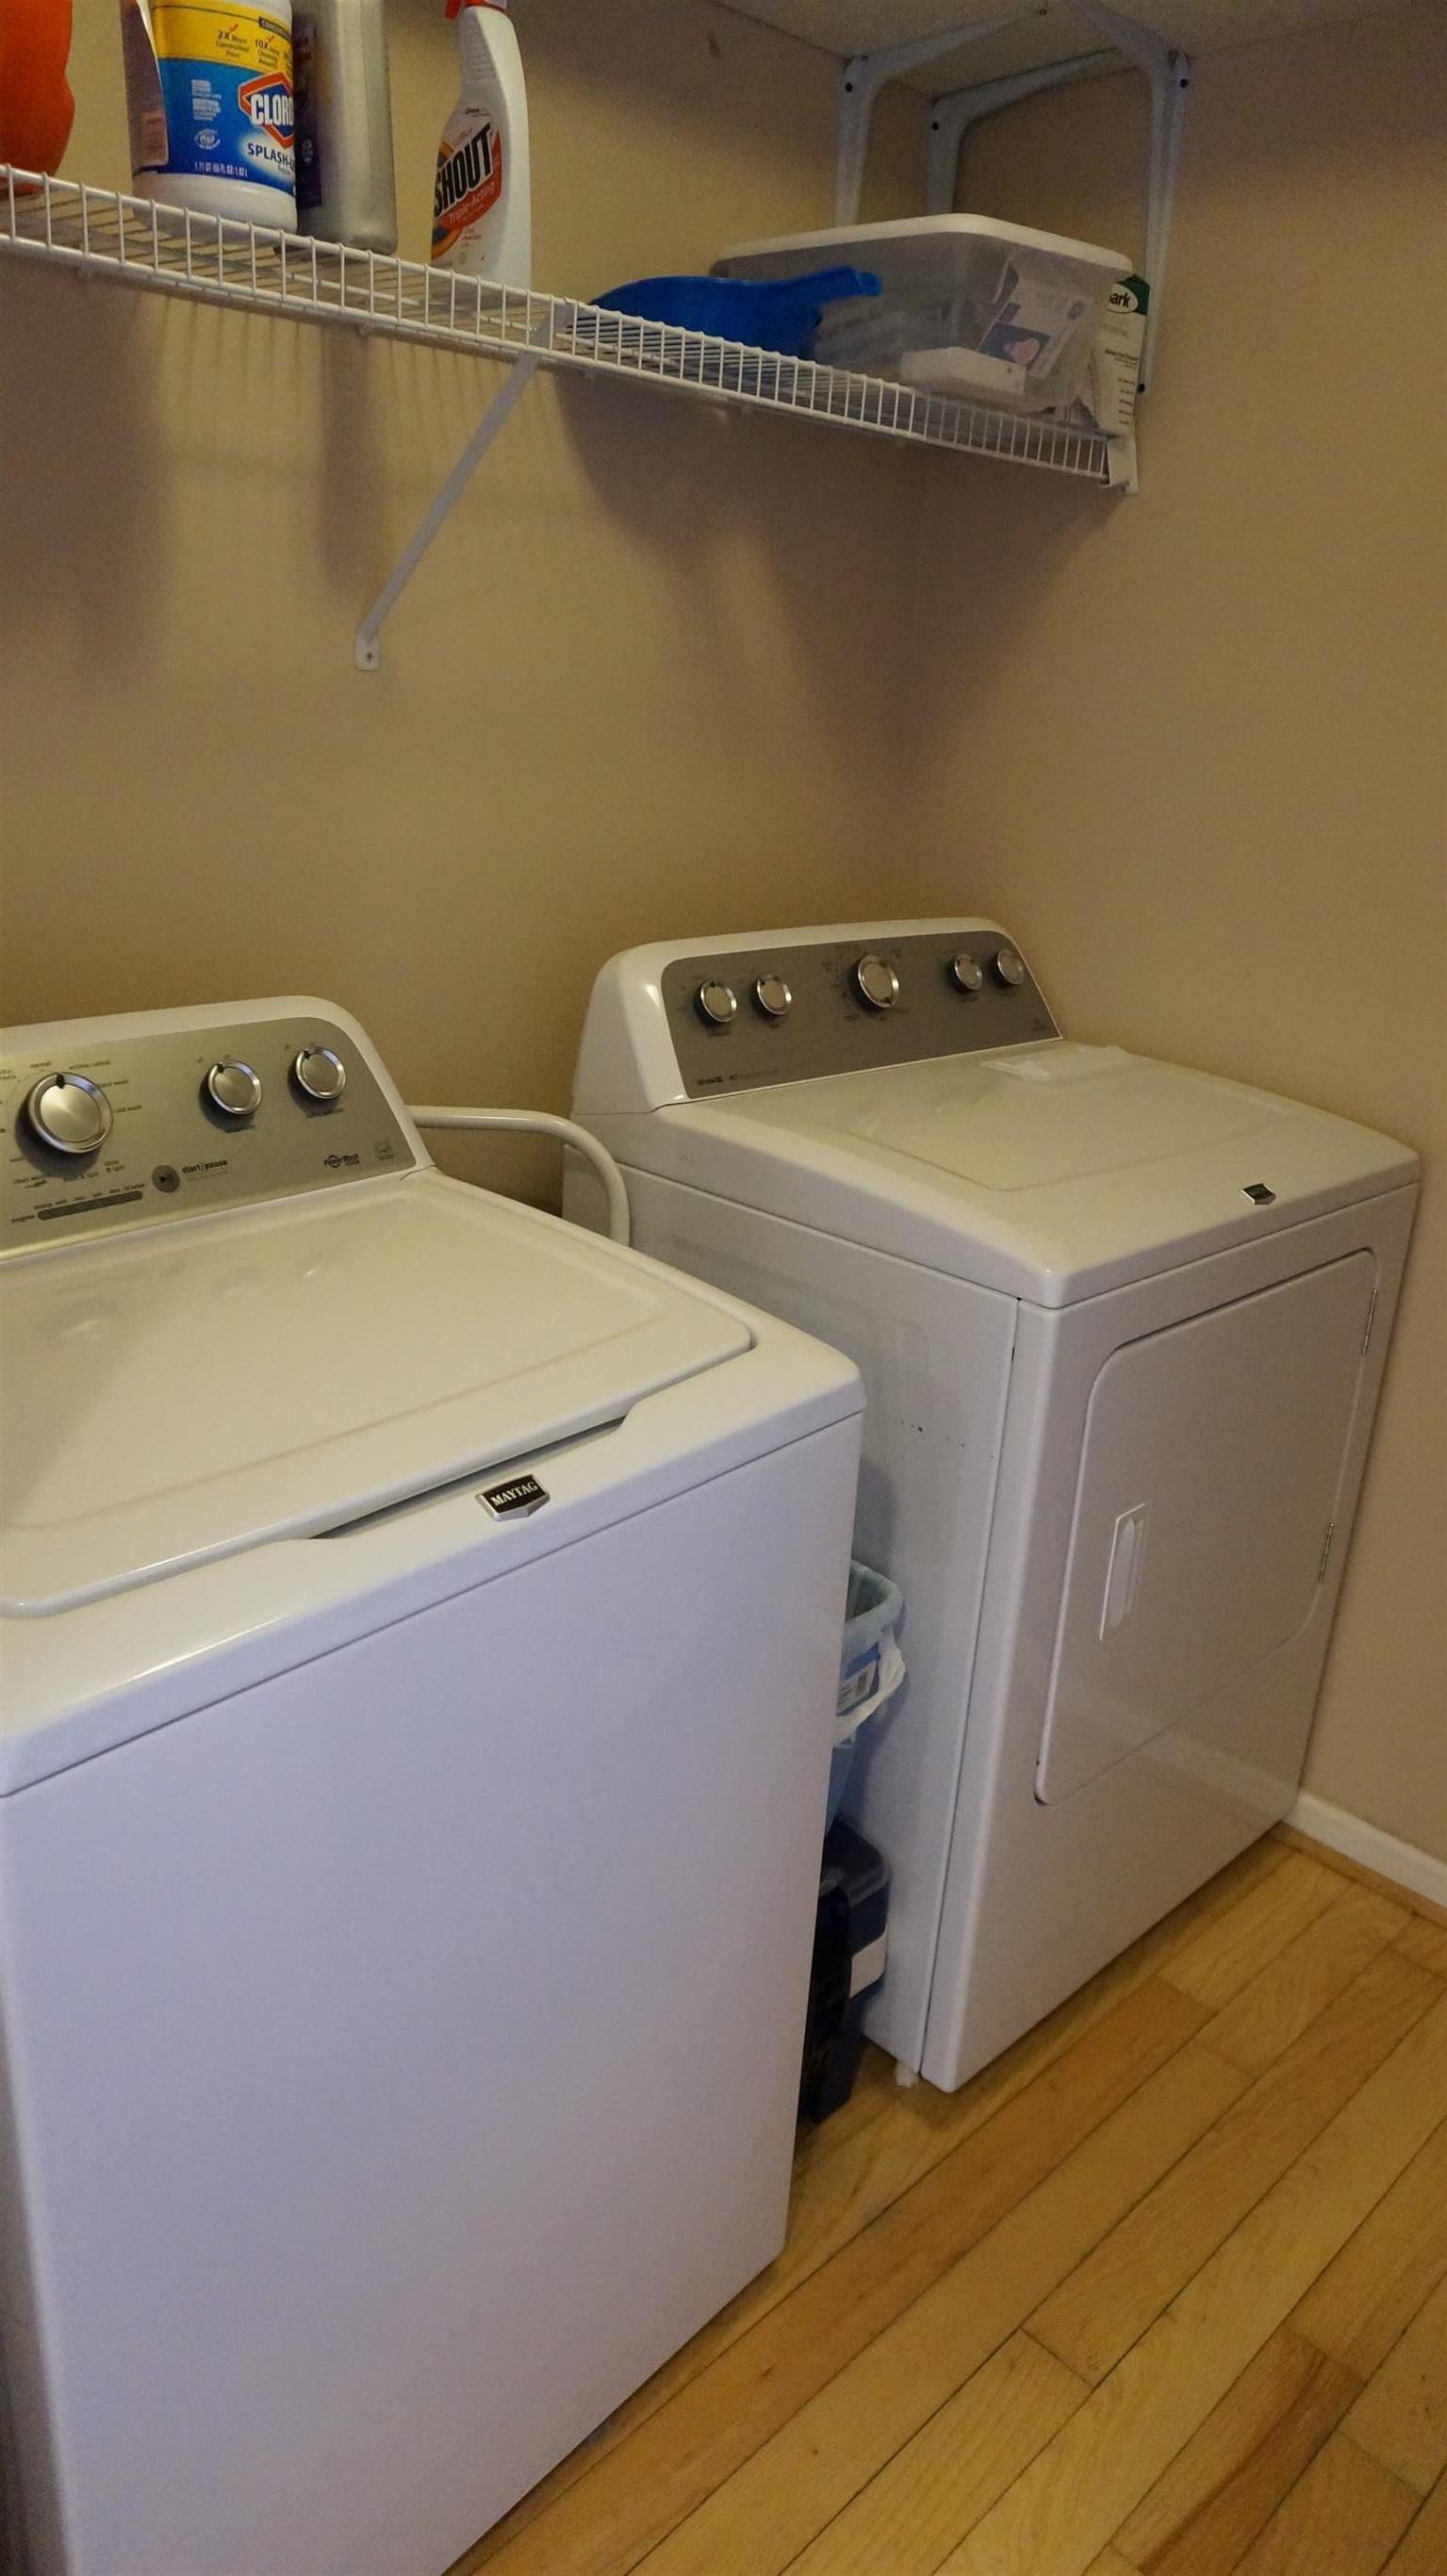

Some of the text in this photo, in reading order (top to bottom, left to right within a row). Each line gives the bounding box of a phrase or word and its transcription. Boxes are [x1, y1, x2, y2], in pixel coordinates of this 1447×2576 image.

[251, 94, 295, 125] CLORO
[435, 123, 491, 219] SHOUT
[490, 1482, 538, 1506] MAYTAG
